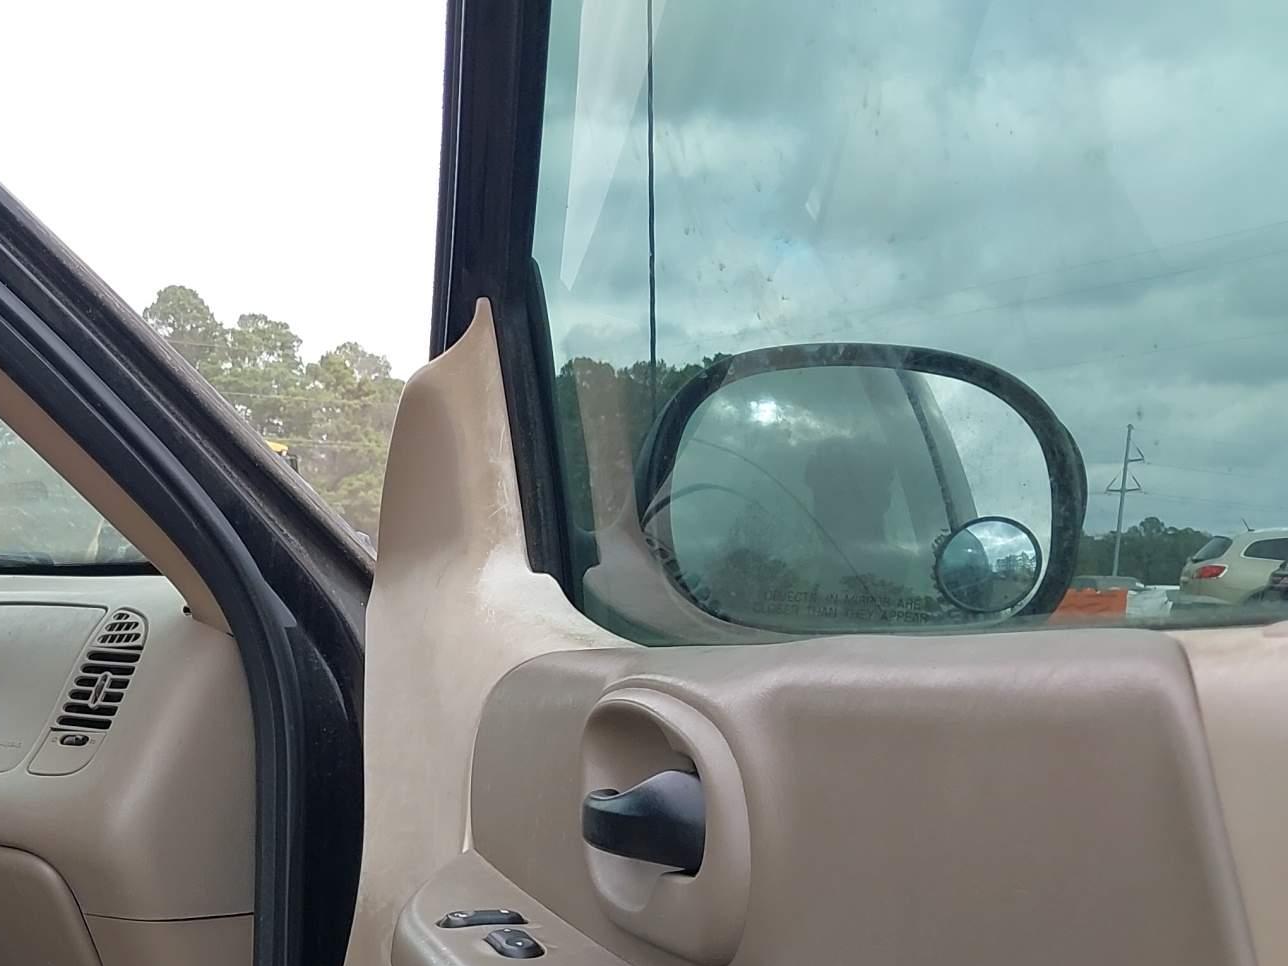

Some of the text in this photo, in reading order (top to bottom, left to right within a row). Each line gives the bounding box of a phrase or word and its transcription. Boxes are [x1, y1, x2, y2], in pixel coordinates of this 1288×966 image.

[896, 597, 921, 610] ARE
[807, 605, 837, 618] THAN
[846, 608, 874, 621] THEY
[880, 610, 930, 624] APPEAR
